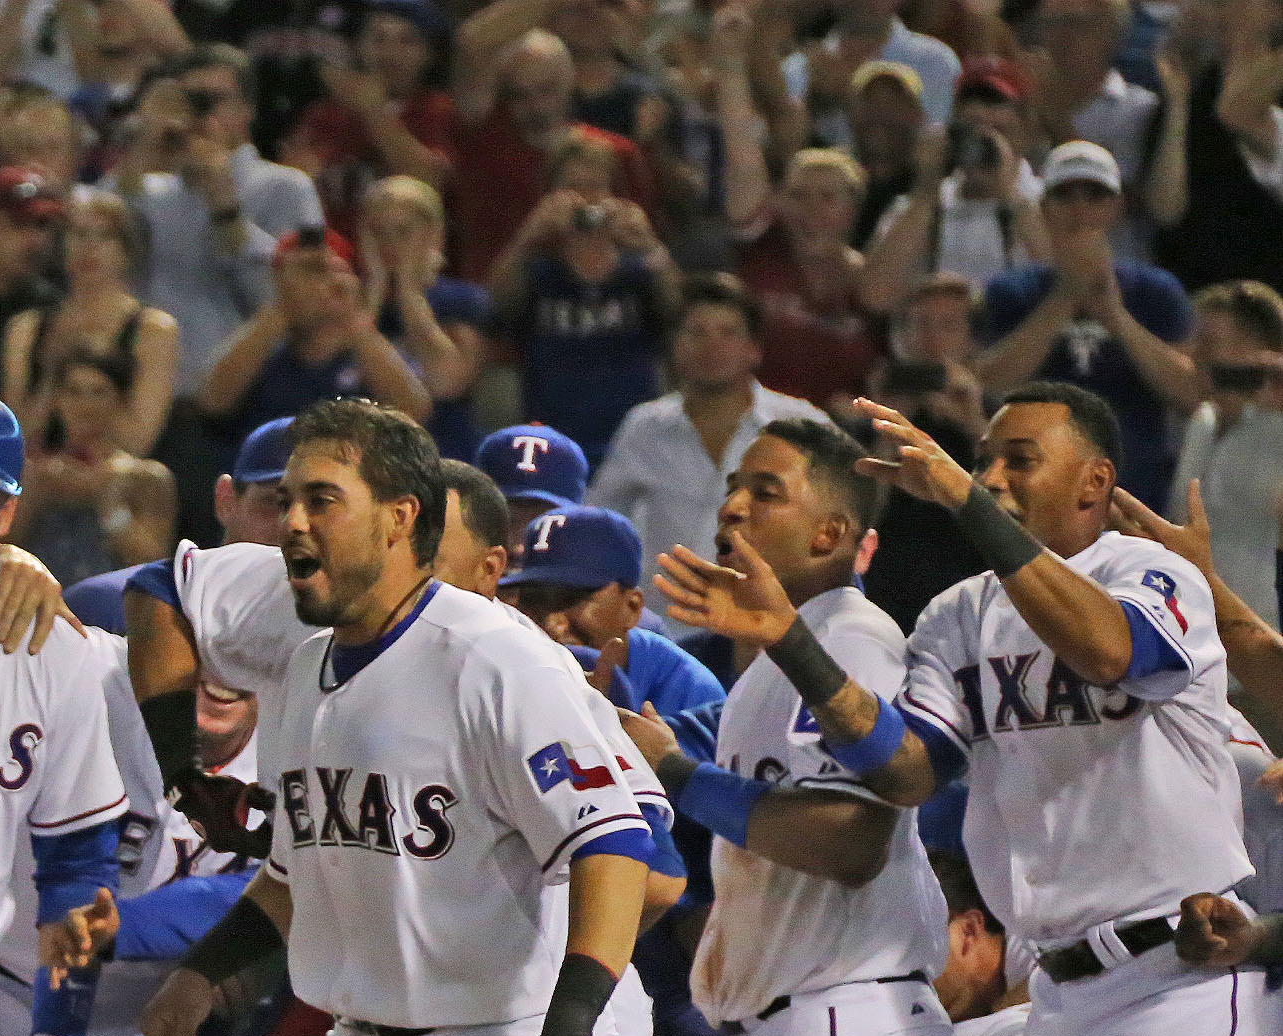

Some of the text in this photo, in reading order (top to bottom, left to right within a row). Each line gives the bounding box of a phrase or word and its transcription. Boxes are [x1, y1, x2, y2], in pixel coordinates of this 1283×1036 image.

[511, 434, 550, 472] T
[533, 514, 567, 551] T
[280, 766, 460, 861] EXAS
